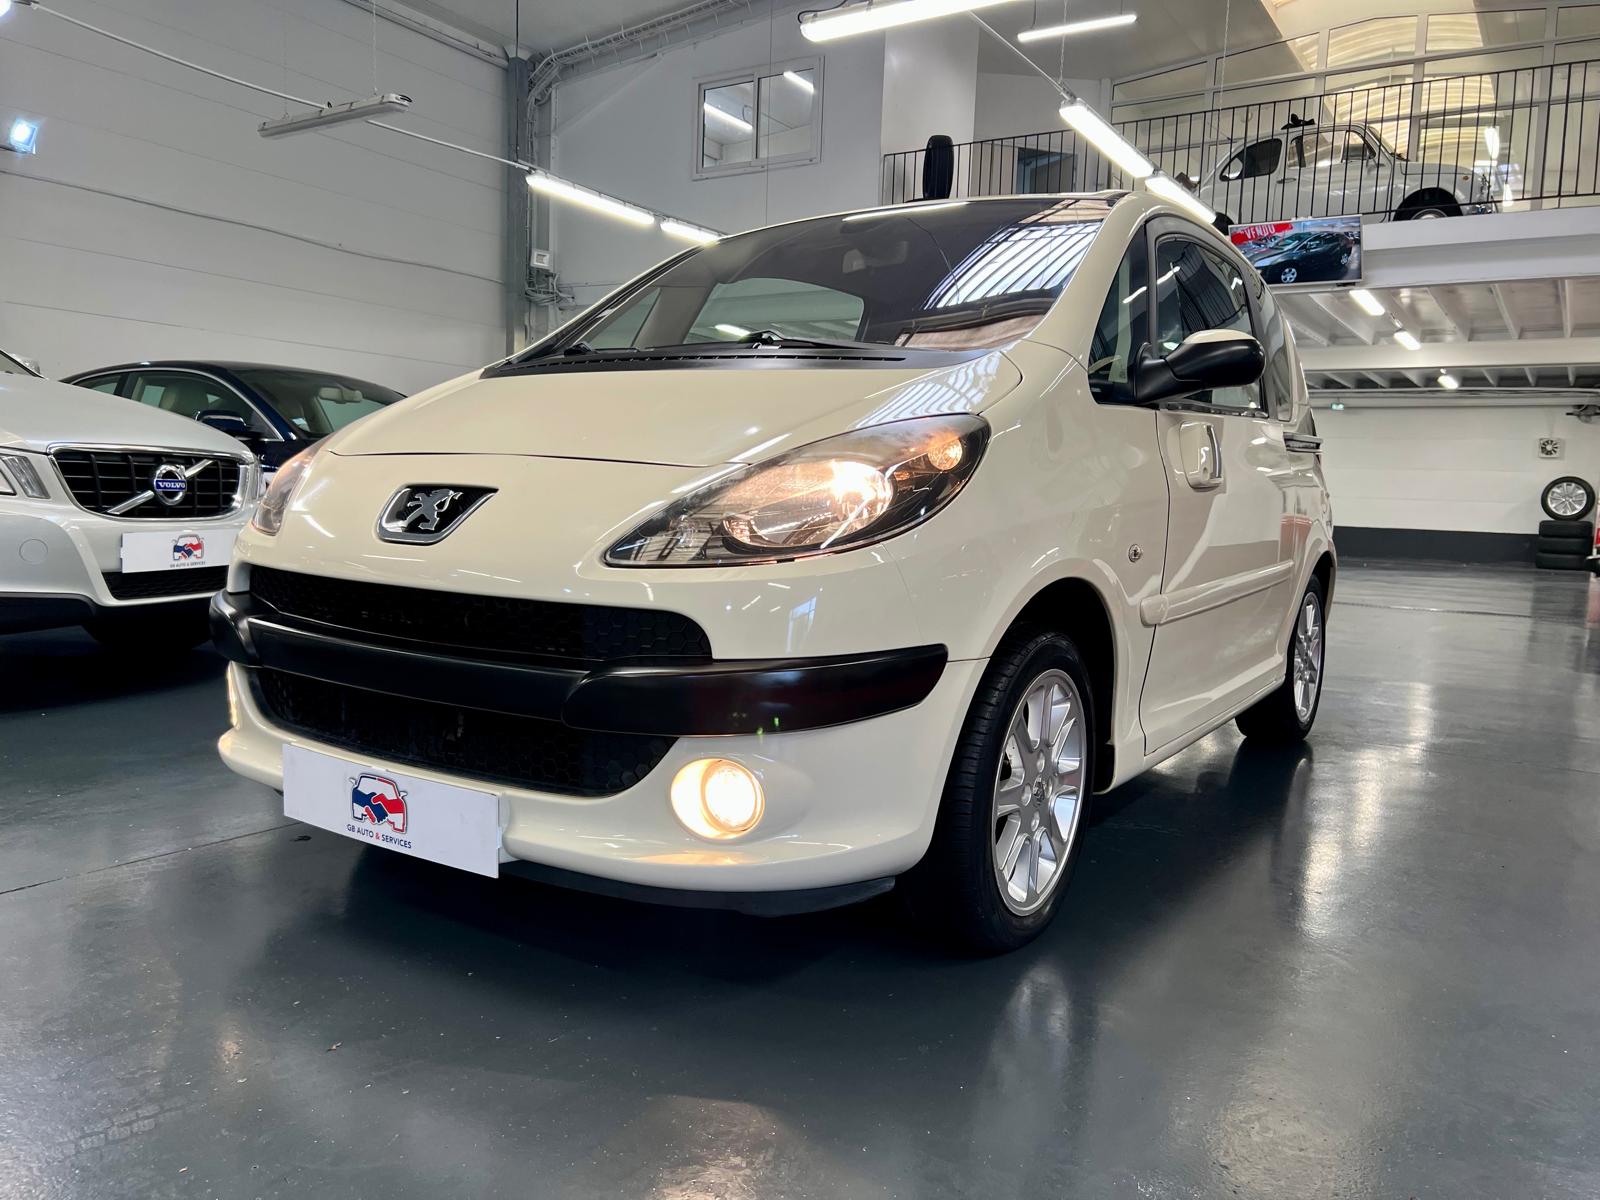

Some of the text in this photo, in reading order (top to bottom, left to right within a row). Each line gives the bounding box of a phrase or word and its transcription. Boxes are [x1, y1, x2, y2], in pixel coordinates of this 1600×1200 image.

[1244, 224, 1276, 239] VENDU
[346, 824, 412, 848] GB AUTO & SERVICES
